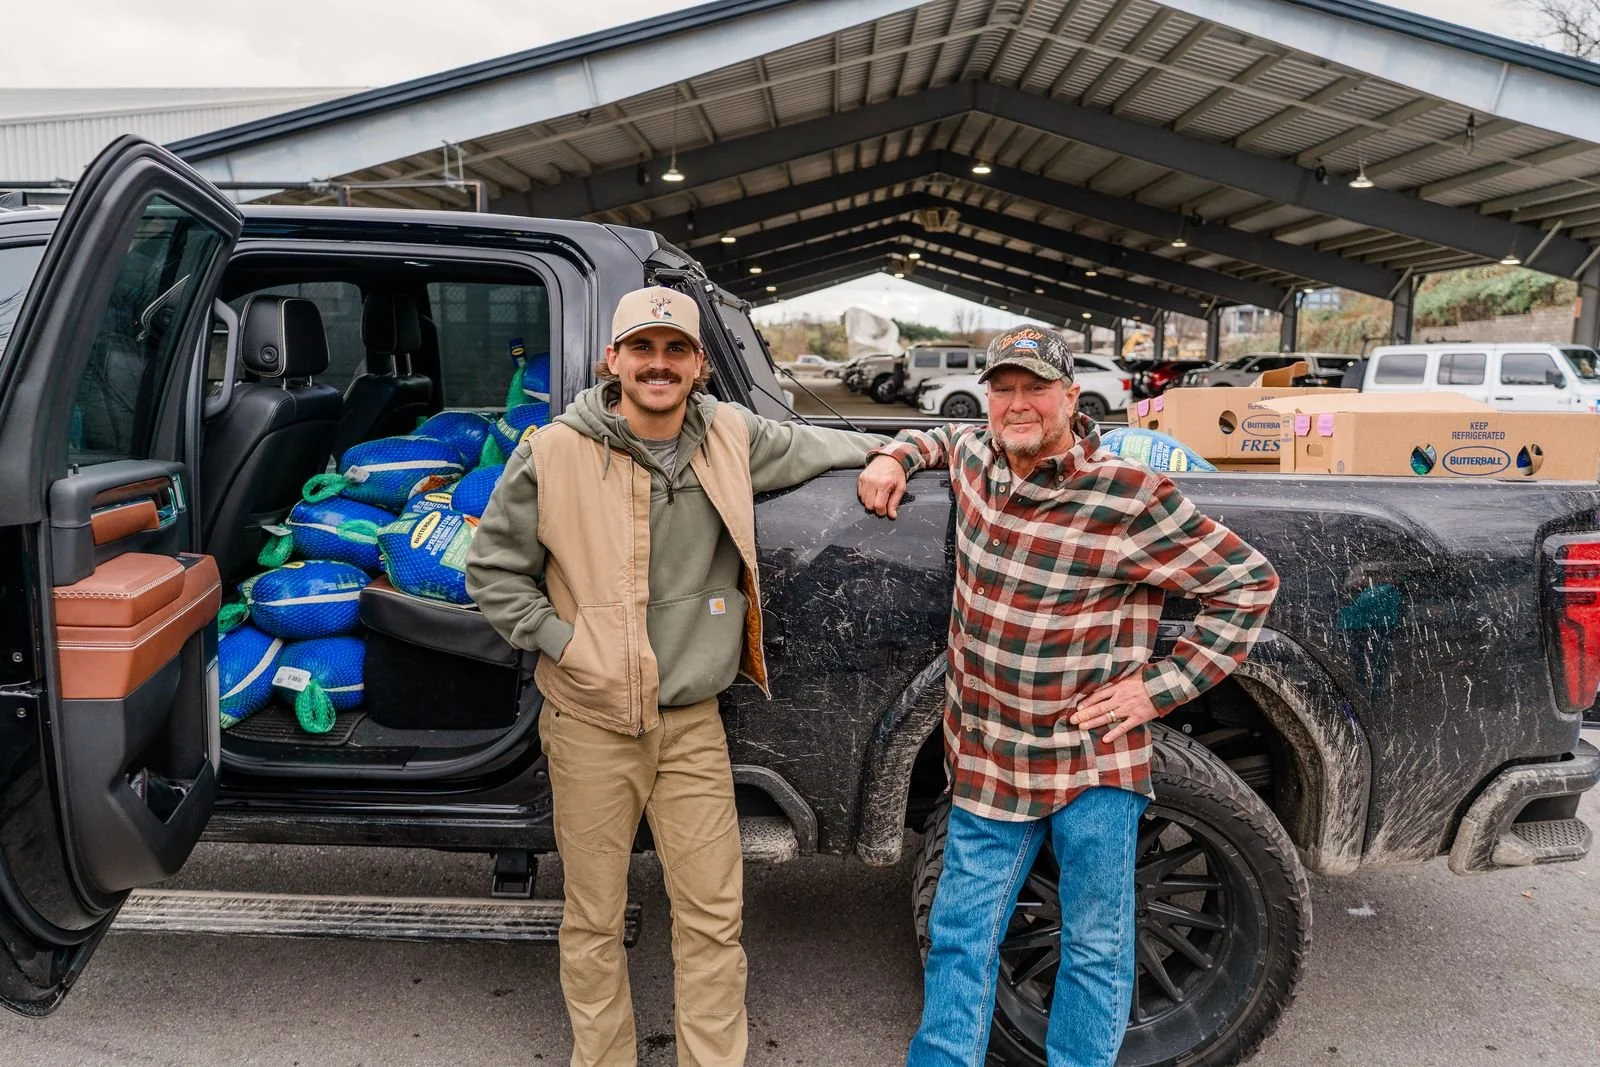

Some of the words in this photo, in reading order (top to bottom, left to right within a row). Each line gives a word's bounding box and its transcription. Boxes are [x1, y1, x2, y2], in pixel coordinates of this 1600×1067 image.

[1470, 422, 1488, 430] KEEP
[1452, 432, 1505, 440] REFRIGERATED
[1241, 440, 1280, 452] FRES
[1161, 445, 1170, 471] PREMIU
[1450, 456, 1502, 465] BUTTERBALL
[417, 501, 449, 509] PREMIUM
[414, 514, 437, 544] BUTTERBALL
[424, 514, 453, 551] PREMIUM
